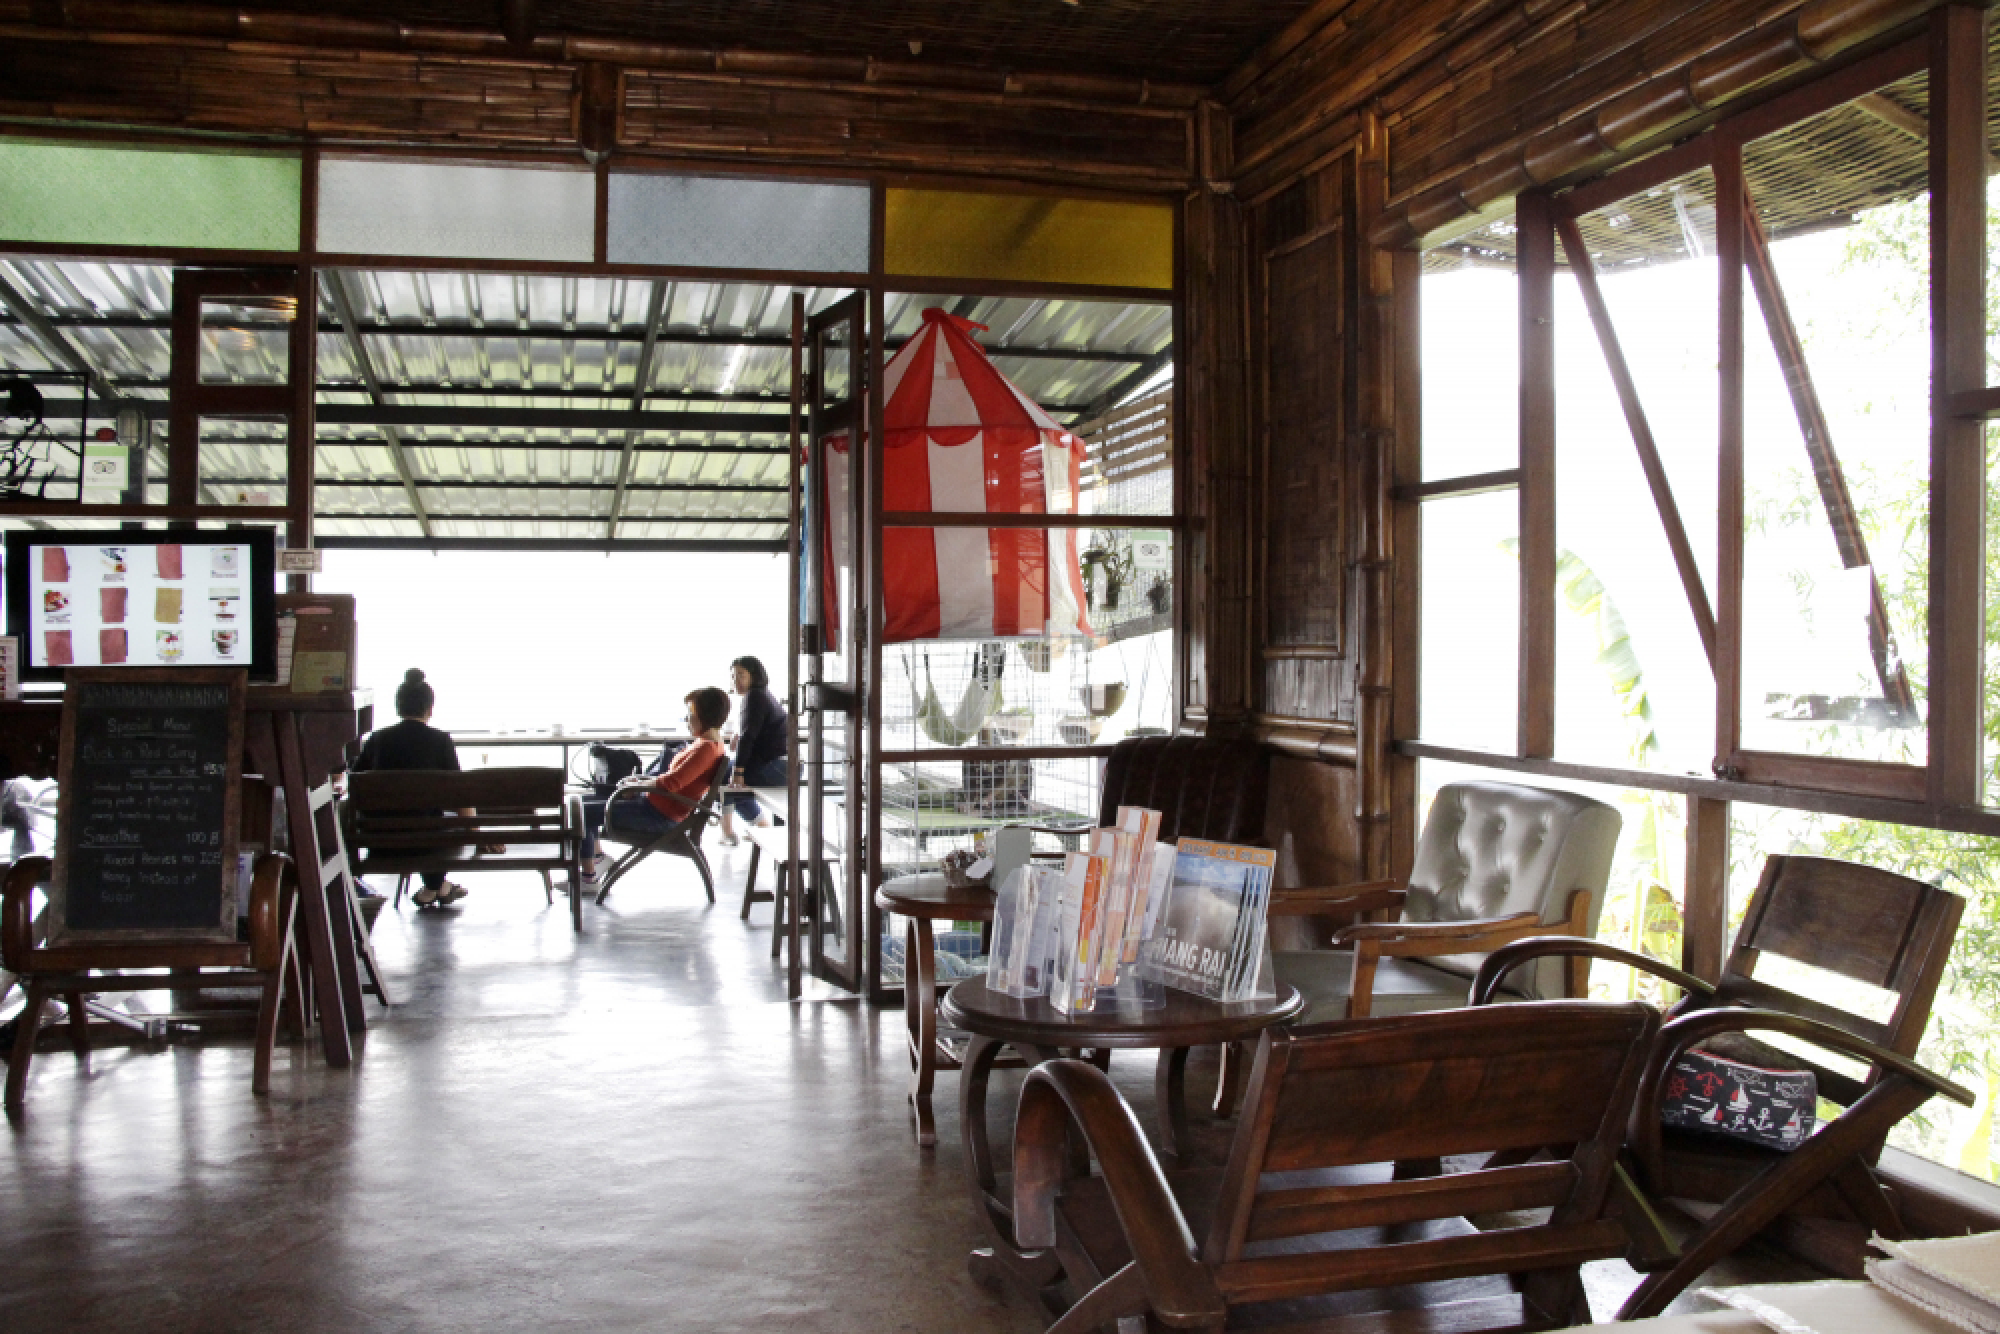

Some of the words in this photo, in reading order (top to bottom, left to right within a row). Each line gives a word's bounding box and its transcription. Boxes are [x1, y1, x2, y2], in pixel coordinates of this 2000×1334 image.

[107, 717, 153, 737] Special
[163, 717, 192, 732] Menu
[83, 826, 141, 846] Smoothie
[1198, 947, 1227, 977] RAI
